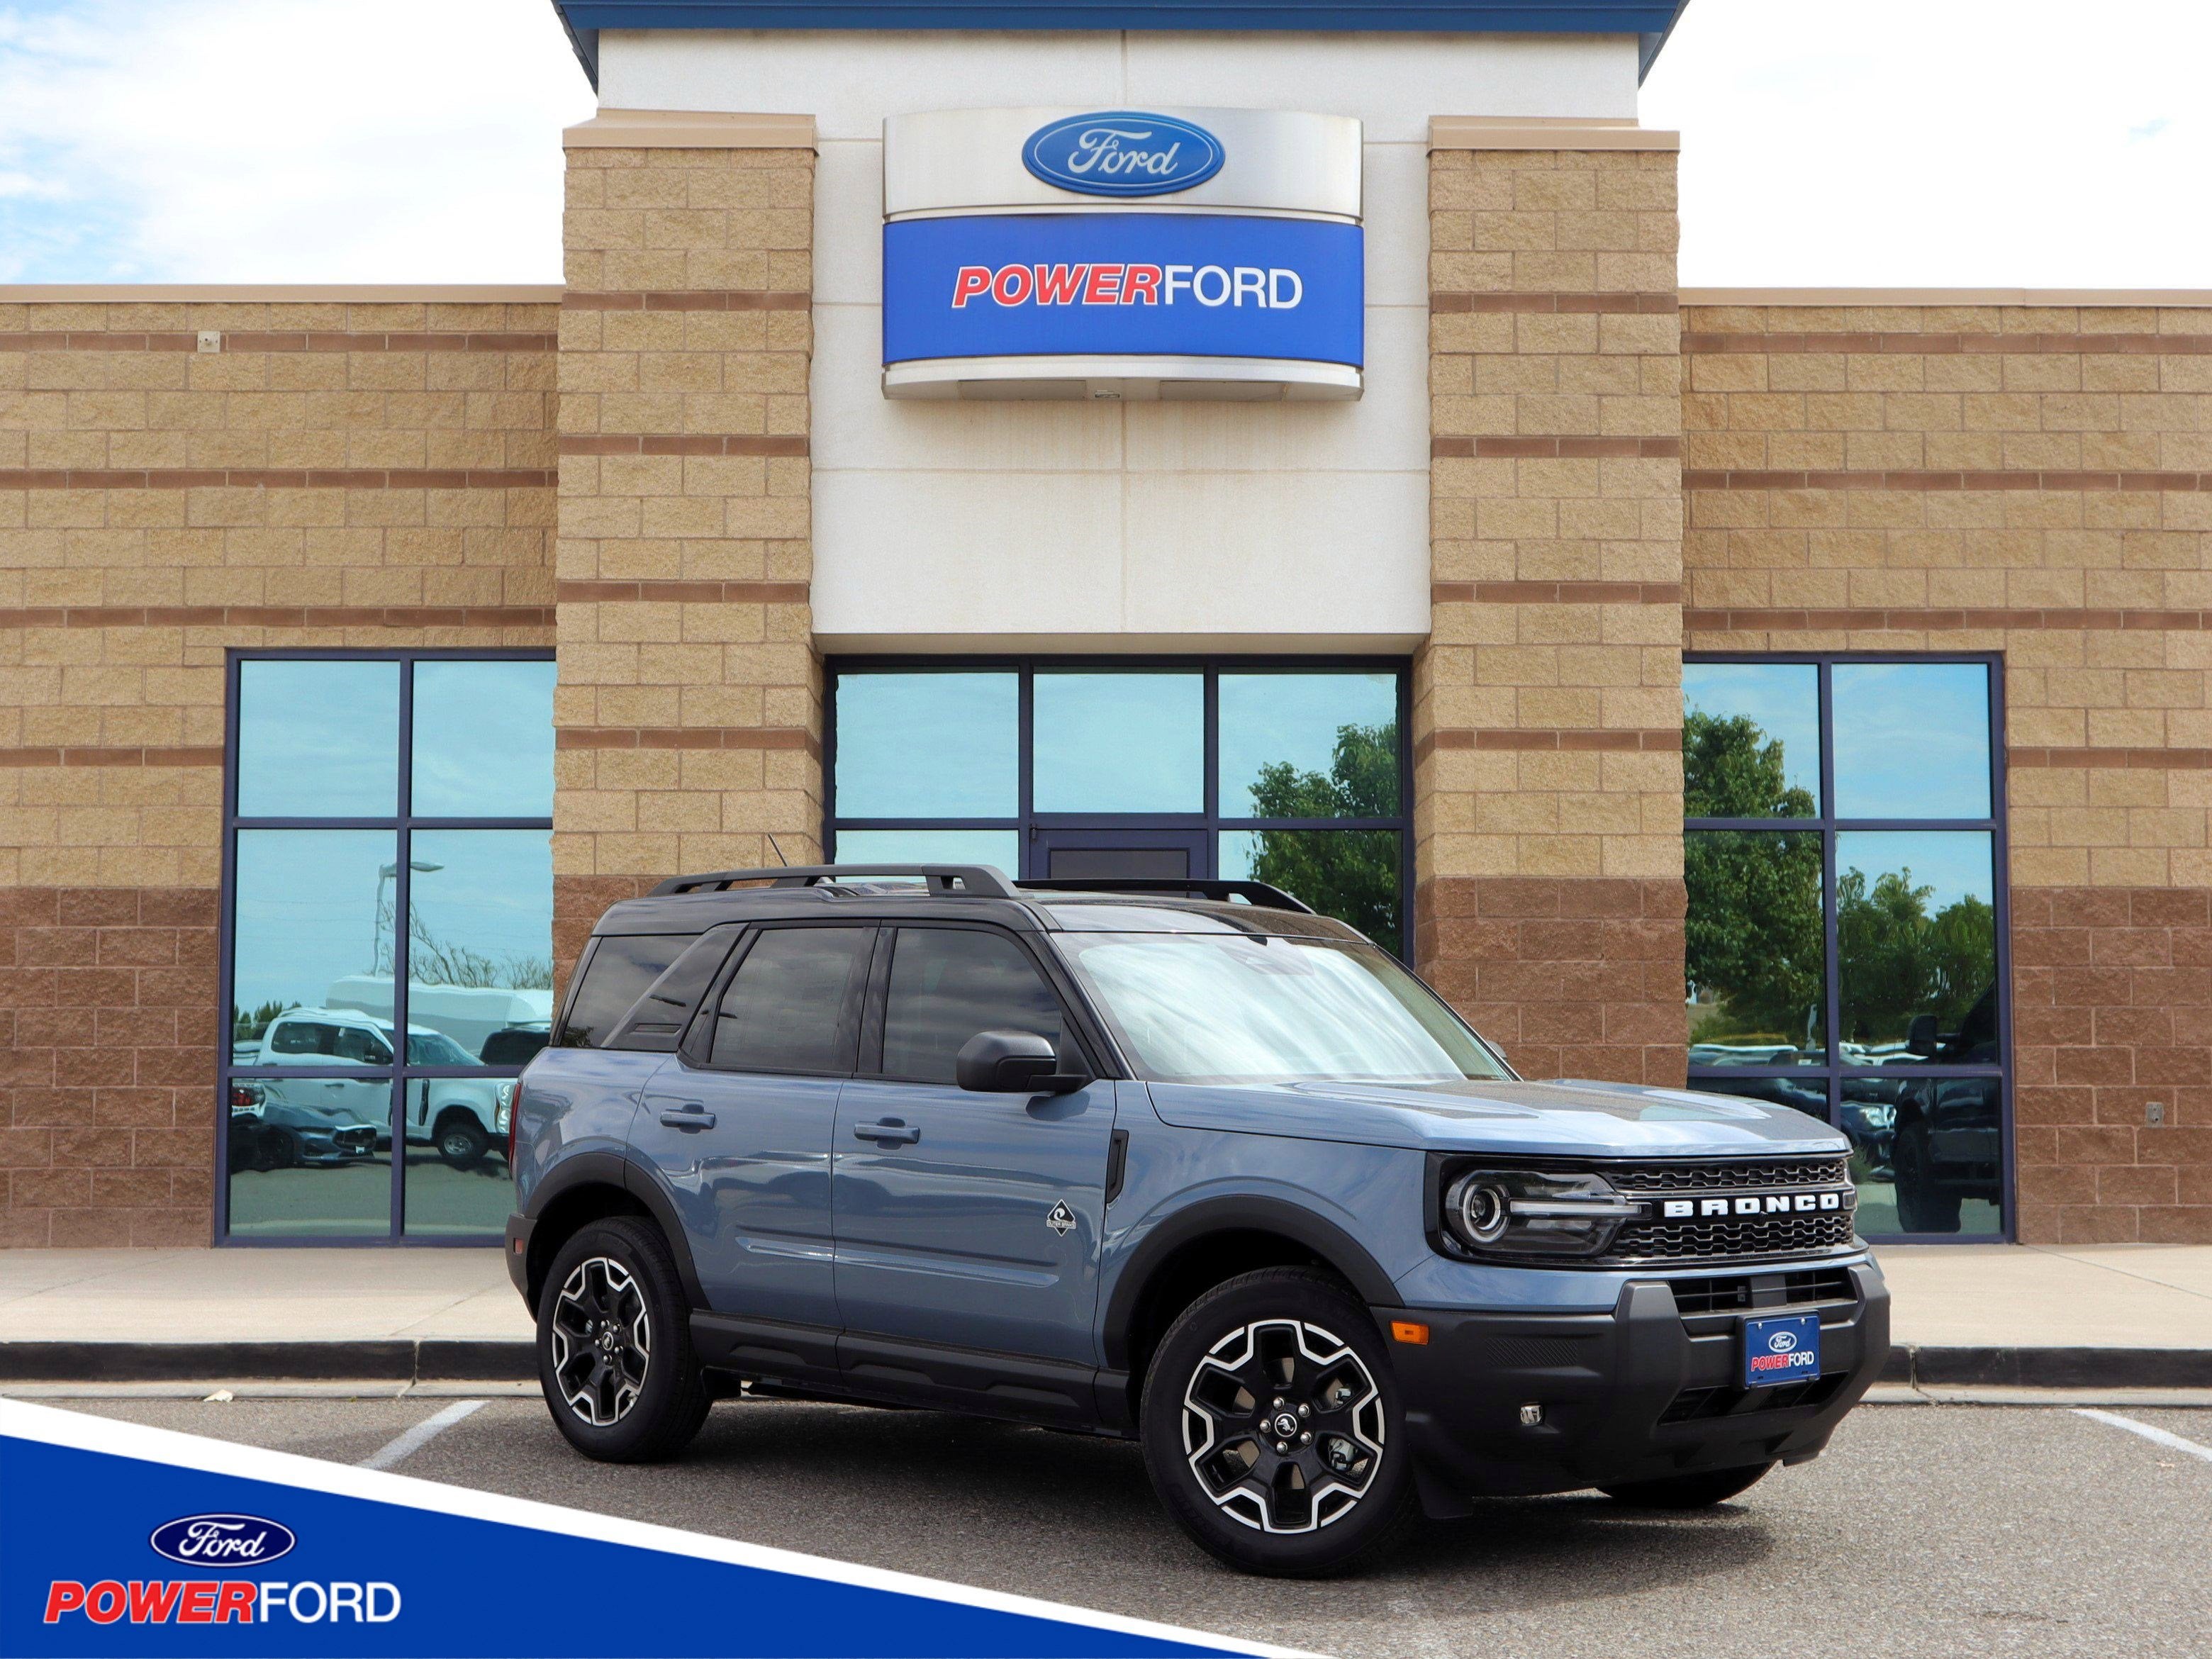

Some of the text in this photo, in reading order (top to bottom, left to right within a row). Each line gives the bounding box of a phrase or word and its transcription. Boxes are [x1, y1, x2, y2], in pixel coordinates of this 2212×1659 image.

[1067, 128, 1180, 176] Ford
[951, 263, 1303, 310] POWERFORD
[1664, 1192, 1839, 1217] BRONCO
[1774, 1336, 1792, 1348] Ford
